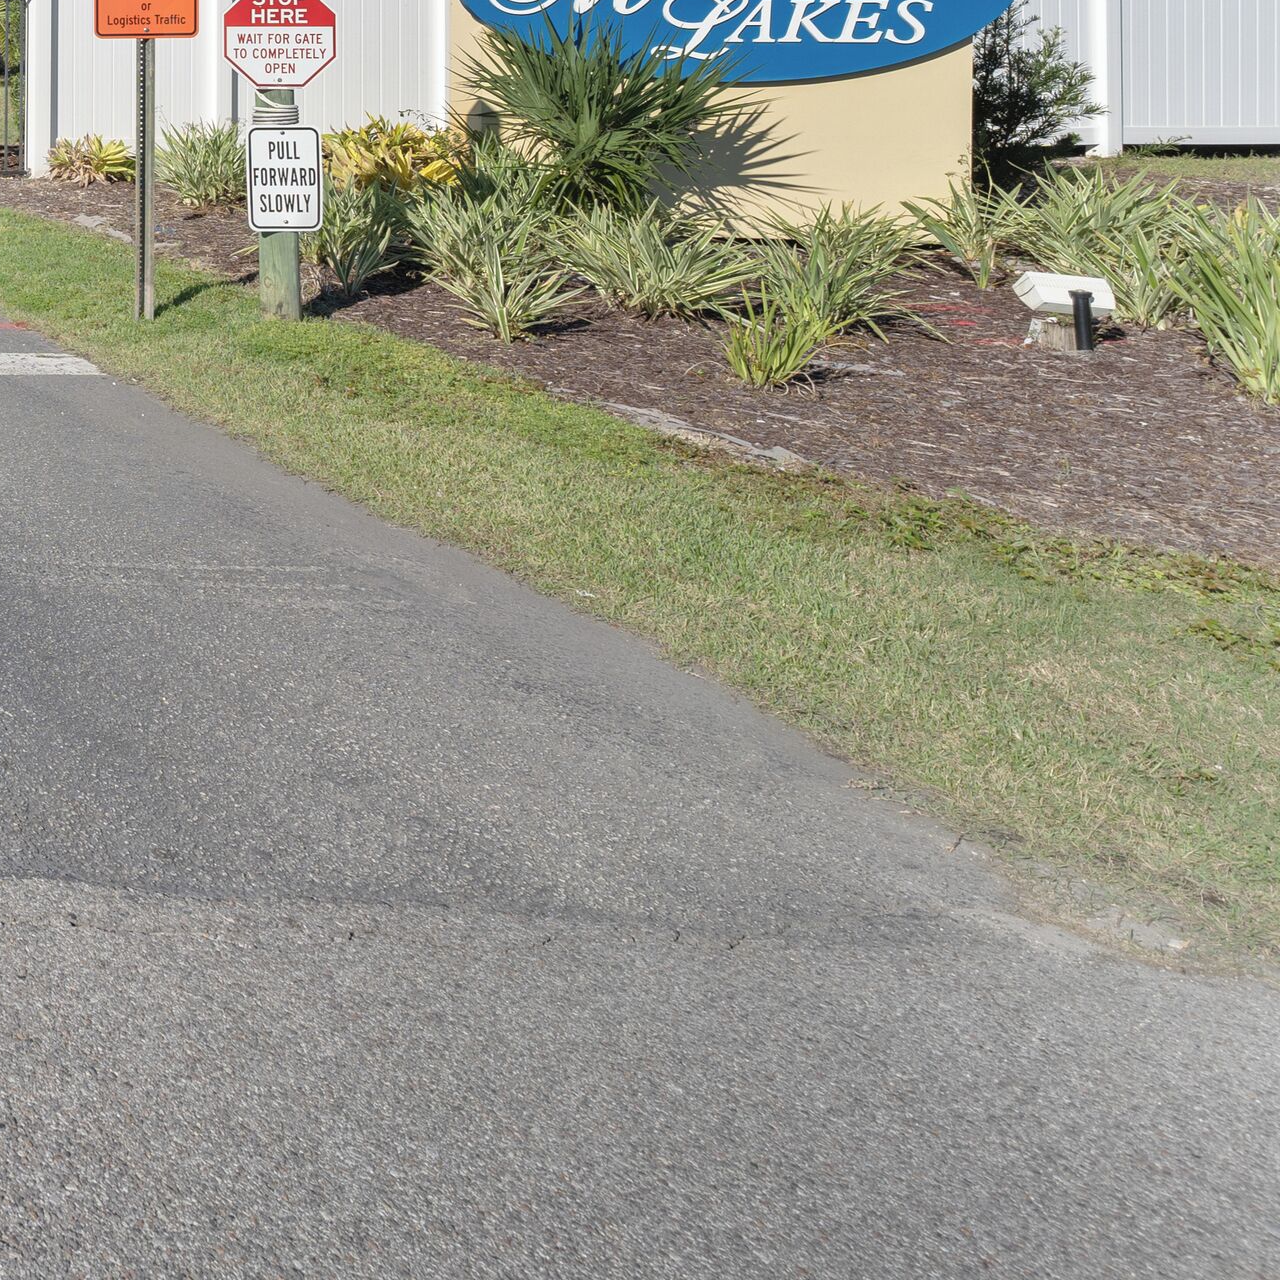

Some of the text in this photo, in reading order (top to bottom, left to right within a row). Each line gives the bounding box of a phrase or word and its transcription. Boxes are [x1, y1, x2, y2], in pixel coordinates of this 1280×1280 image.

[141, 2, 151, 11] or
[107, 14, 186, 28] Logistics Traffic
[251, 8, 308, 24] HERE
[237, 33, 323, 44] WAIT FOR GATE
[233, 48, 326, 59] TO COMPLETELY
[265, 63, 296, 74] OPEN
[268, 141, 300, 160] PULL
[253, 167, 316, 186] FORWARD
[260, 194, 311, 213] SLOWLY
